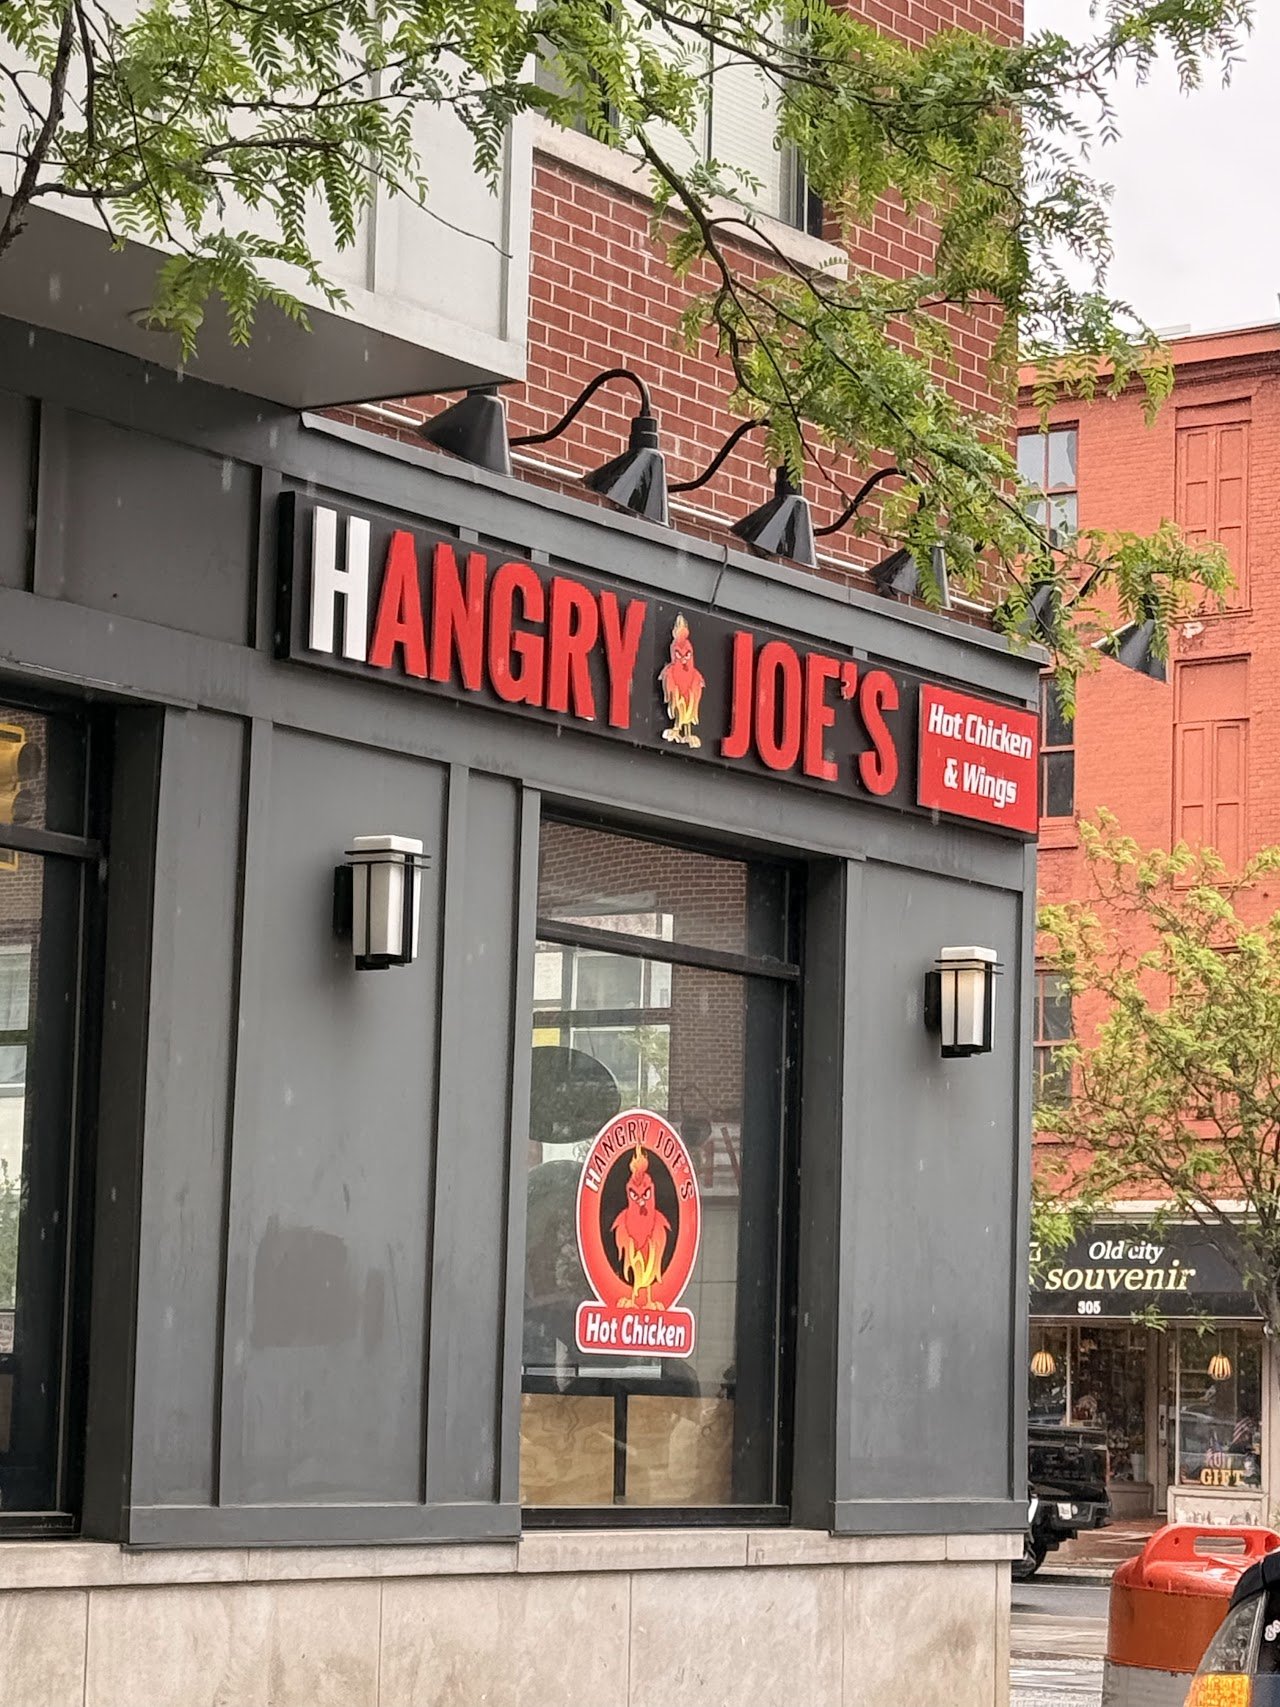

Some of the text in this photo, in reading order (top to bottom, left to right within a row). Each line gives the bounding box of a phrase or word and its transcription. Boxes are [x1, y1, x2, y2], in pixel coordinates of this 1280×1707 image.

[309, 505, 899, 796] HANGRY JOE'S
[928, 703, 1032, 760] Hot Chicken
[943, 758, 1017, 809] & Wings
[585, 1119, 694, 1201] HANGRY JOE'S
[1088, 1240, 1165, 1264] Old city
[1045, 1259, 1196, 1291] souvenir
[1077, 1300, 1101, 1315] 305
[585, 1312, 686, 1348] Hot Chicken
[1200, 1468, 1244, 1486] GIFT
